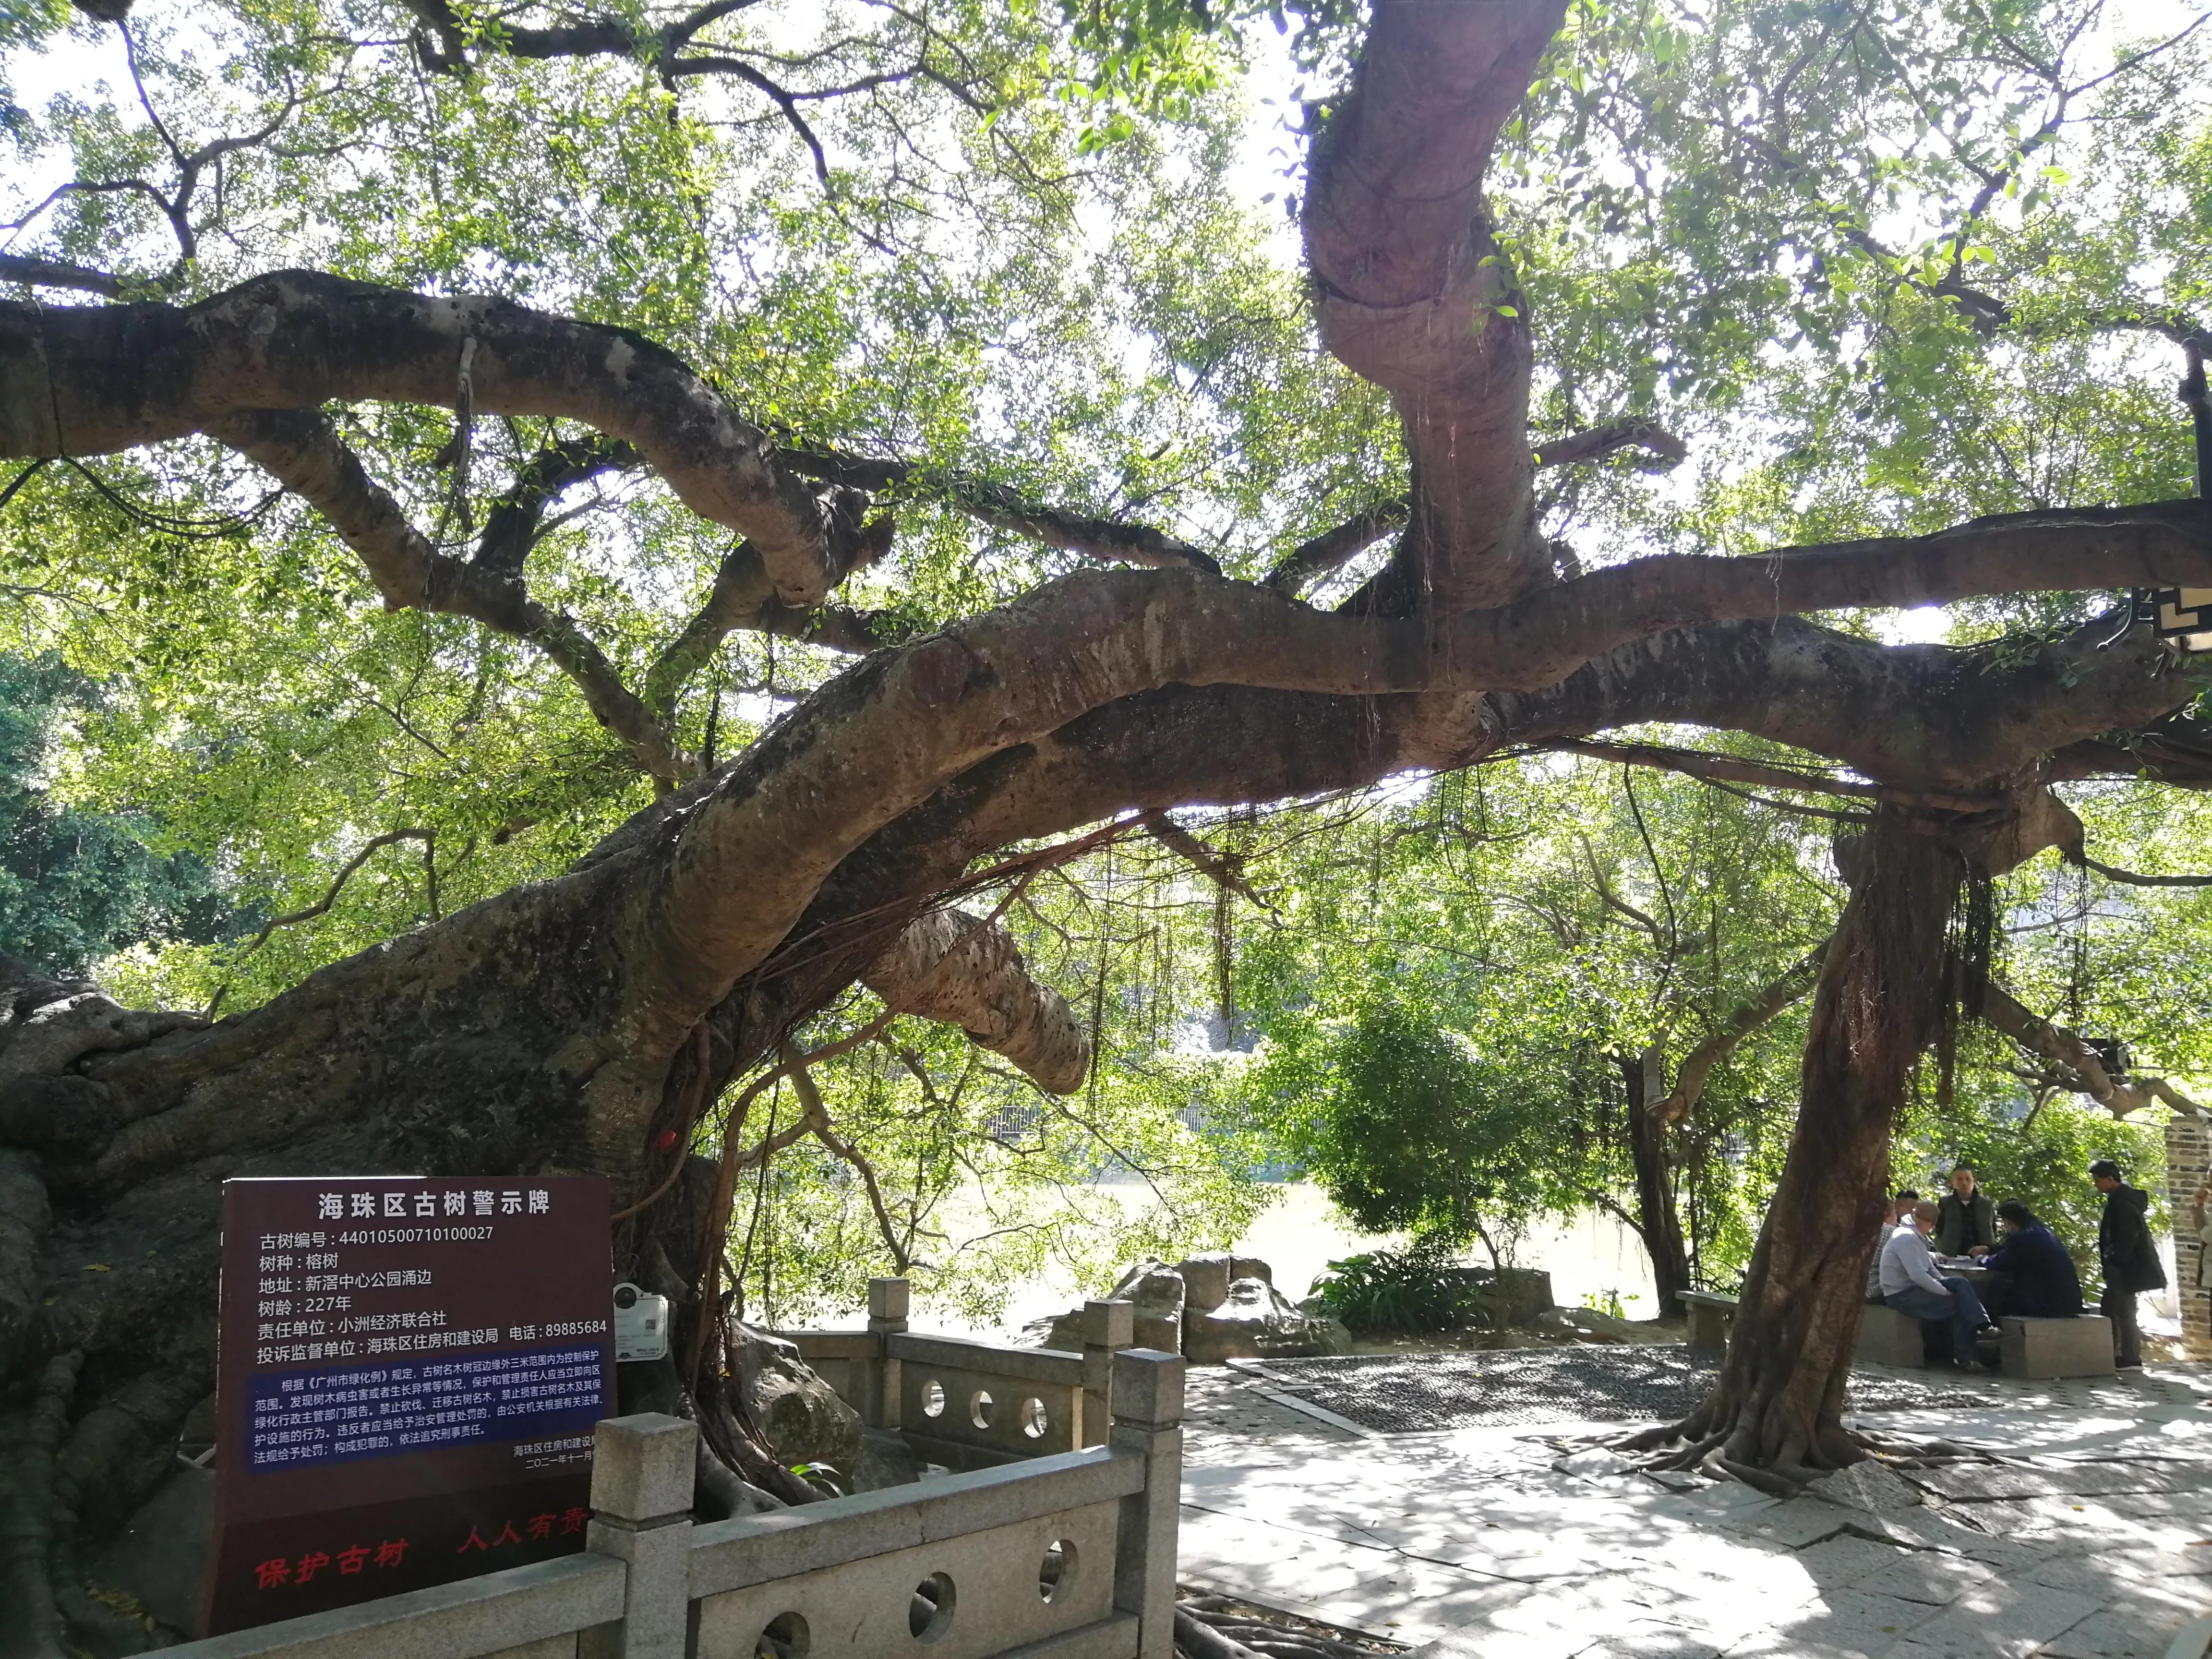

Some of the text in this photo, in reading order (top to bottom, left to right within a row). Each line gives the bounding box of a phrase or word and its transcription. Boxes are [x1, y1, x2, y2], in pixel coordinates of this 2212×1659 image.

[319, 1190, 550, 1219] 海珠区古树警示牌
[259, 1227, 493, 1250] 古树编号：44010500710100027
[259, 1252, 339, 1273] 树种：榕树
[258, 1296, 352, 1317] 树龄：227年
[257, 1310, 447, 1340] 责任单位：小洲经济联合社
[257, 1320, 607, 1365] 投诉监督单位：海珠区住房和建设局 电话：89885684
[255, 1507, 588, 1589] 保护古树 人人有责
